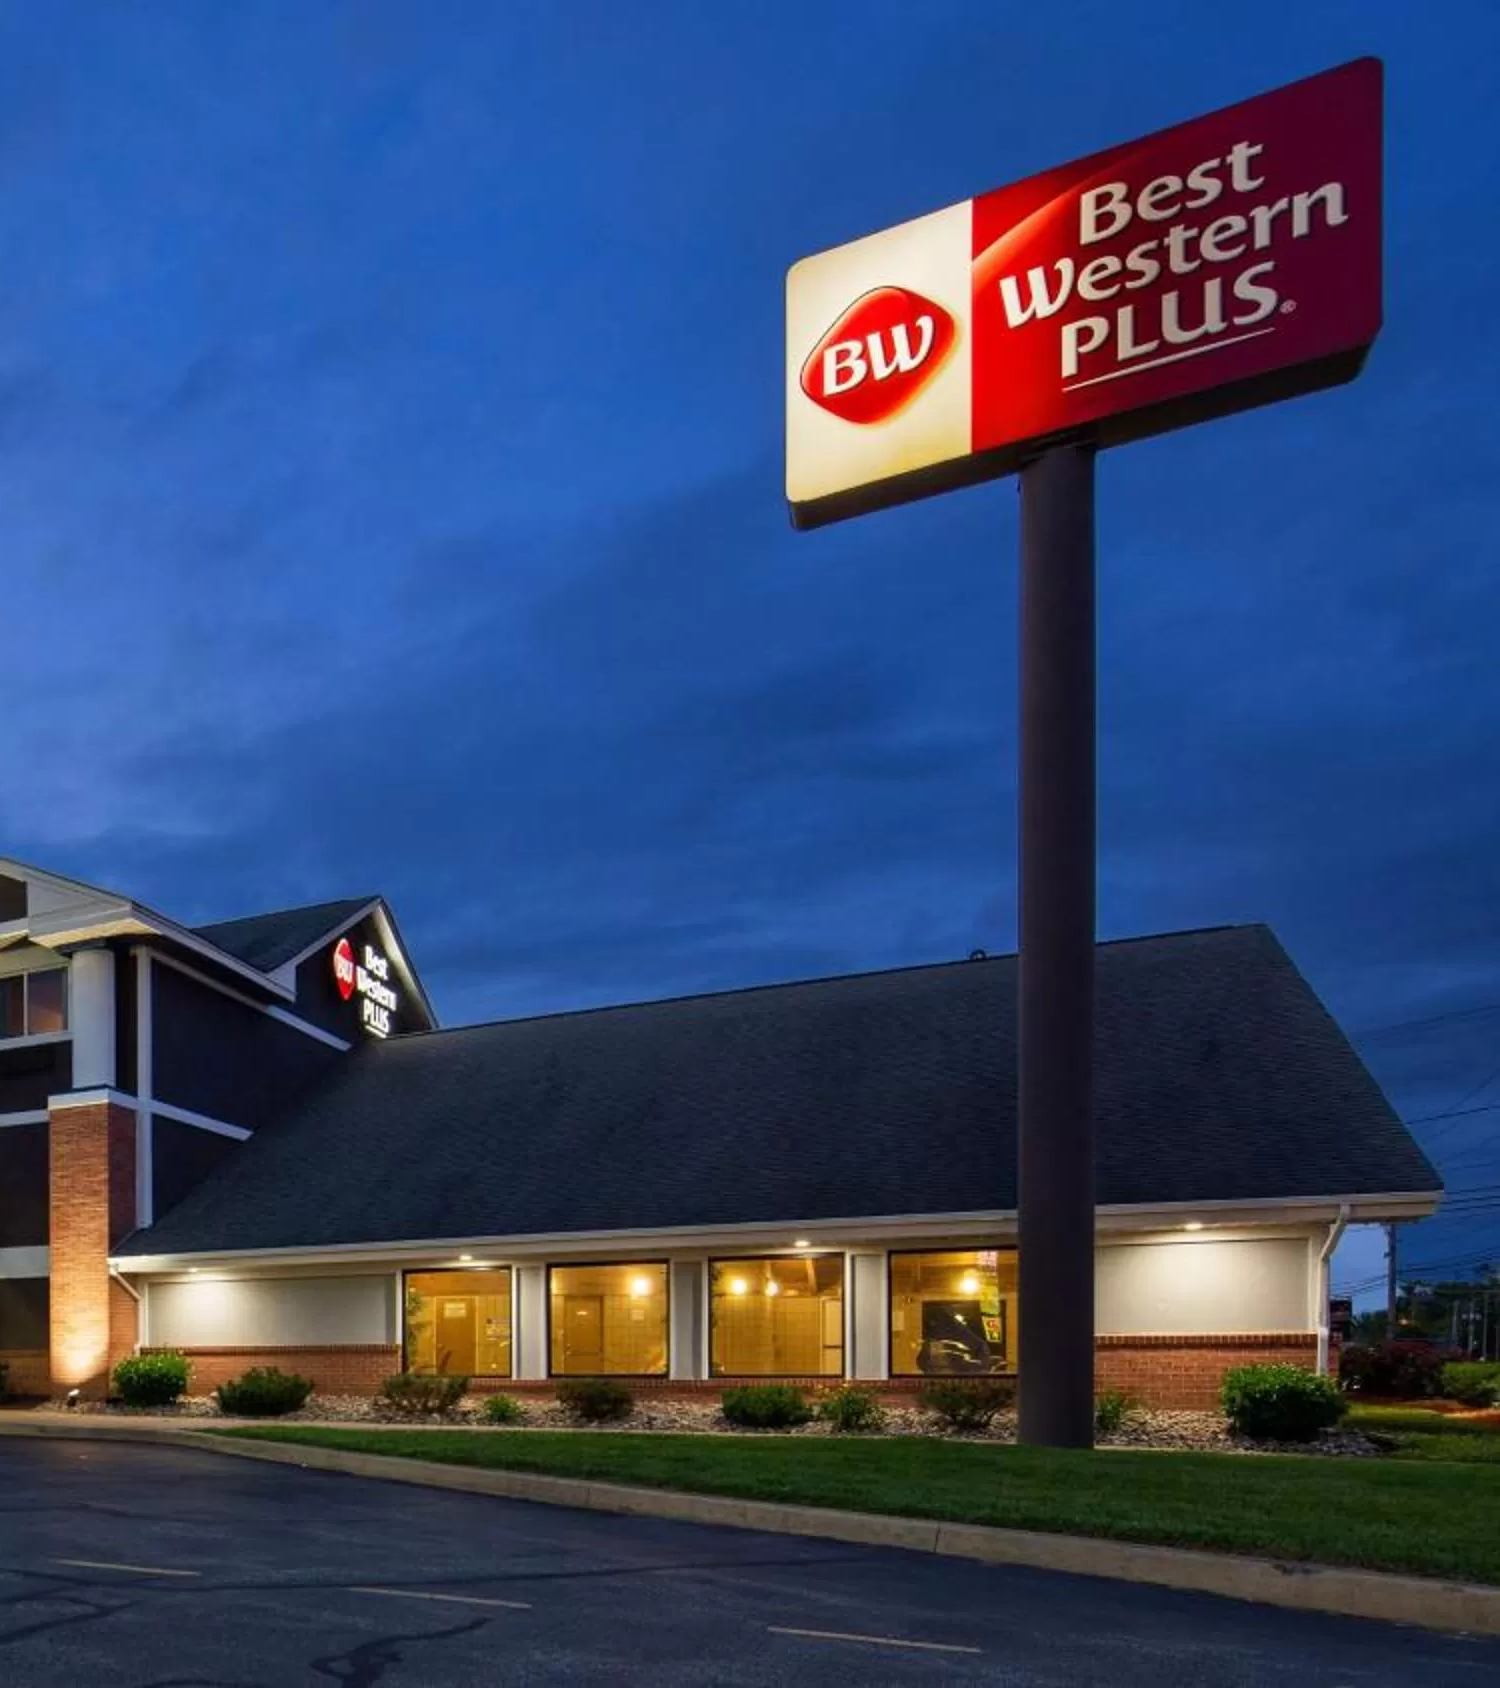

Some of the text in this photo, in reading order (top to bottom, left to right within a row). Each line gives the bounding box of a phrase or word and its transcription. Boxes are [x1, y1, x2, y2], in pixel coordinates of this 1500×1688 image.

[1079, 140, 1265, 246] Best
[999, 181, 1349, 329] Western
[821, 313, 935, 397] BW
[1061, 261, 1281, 378] PLUS
